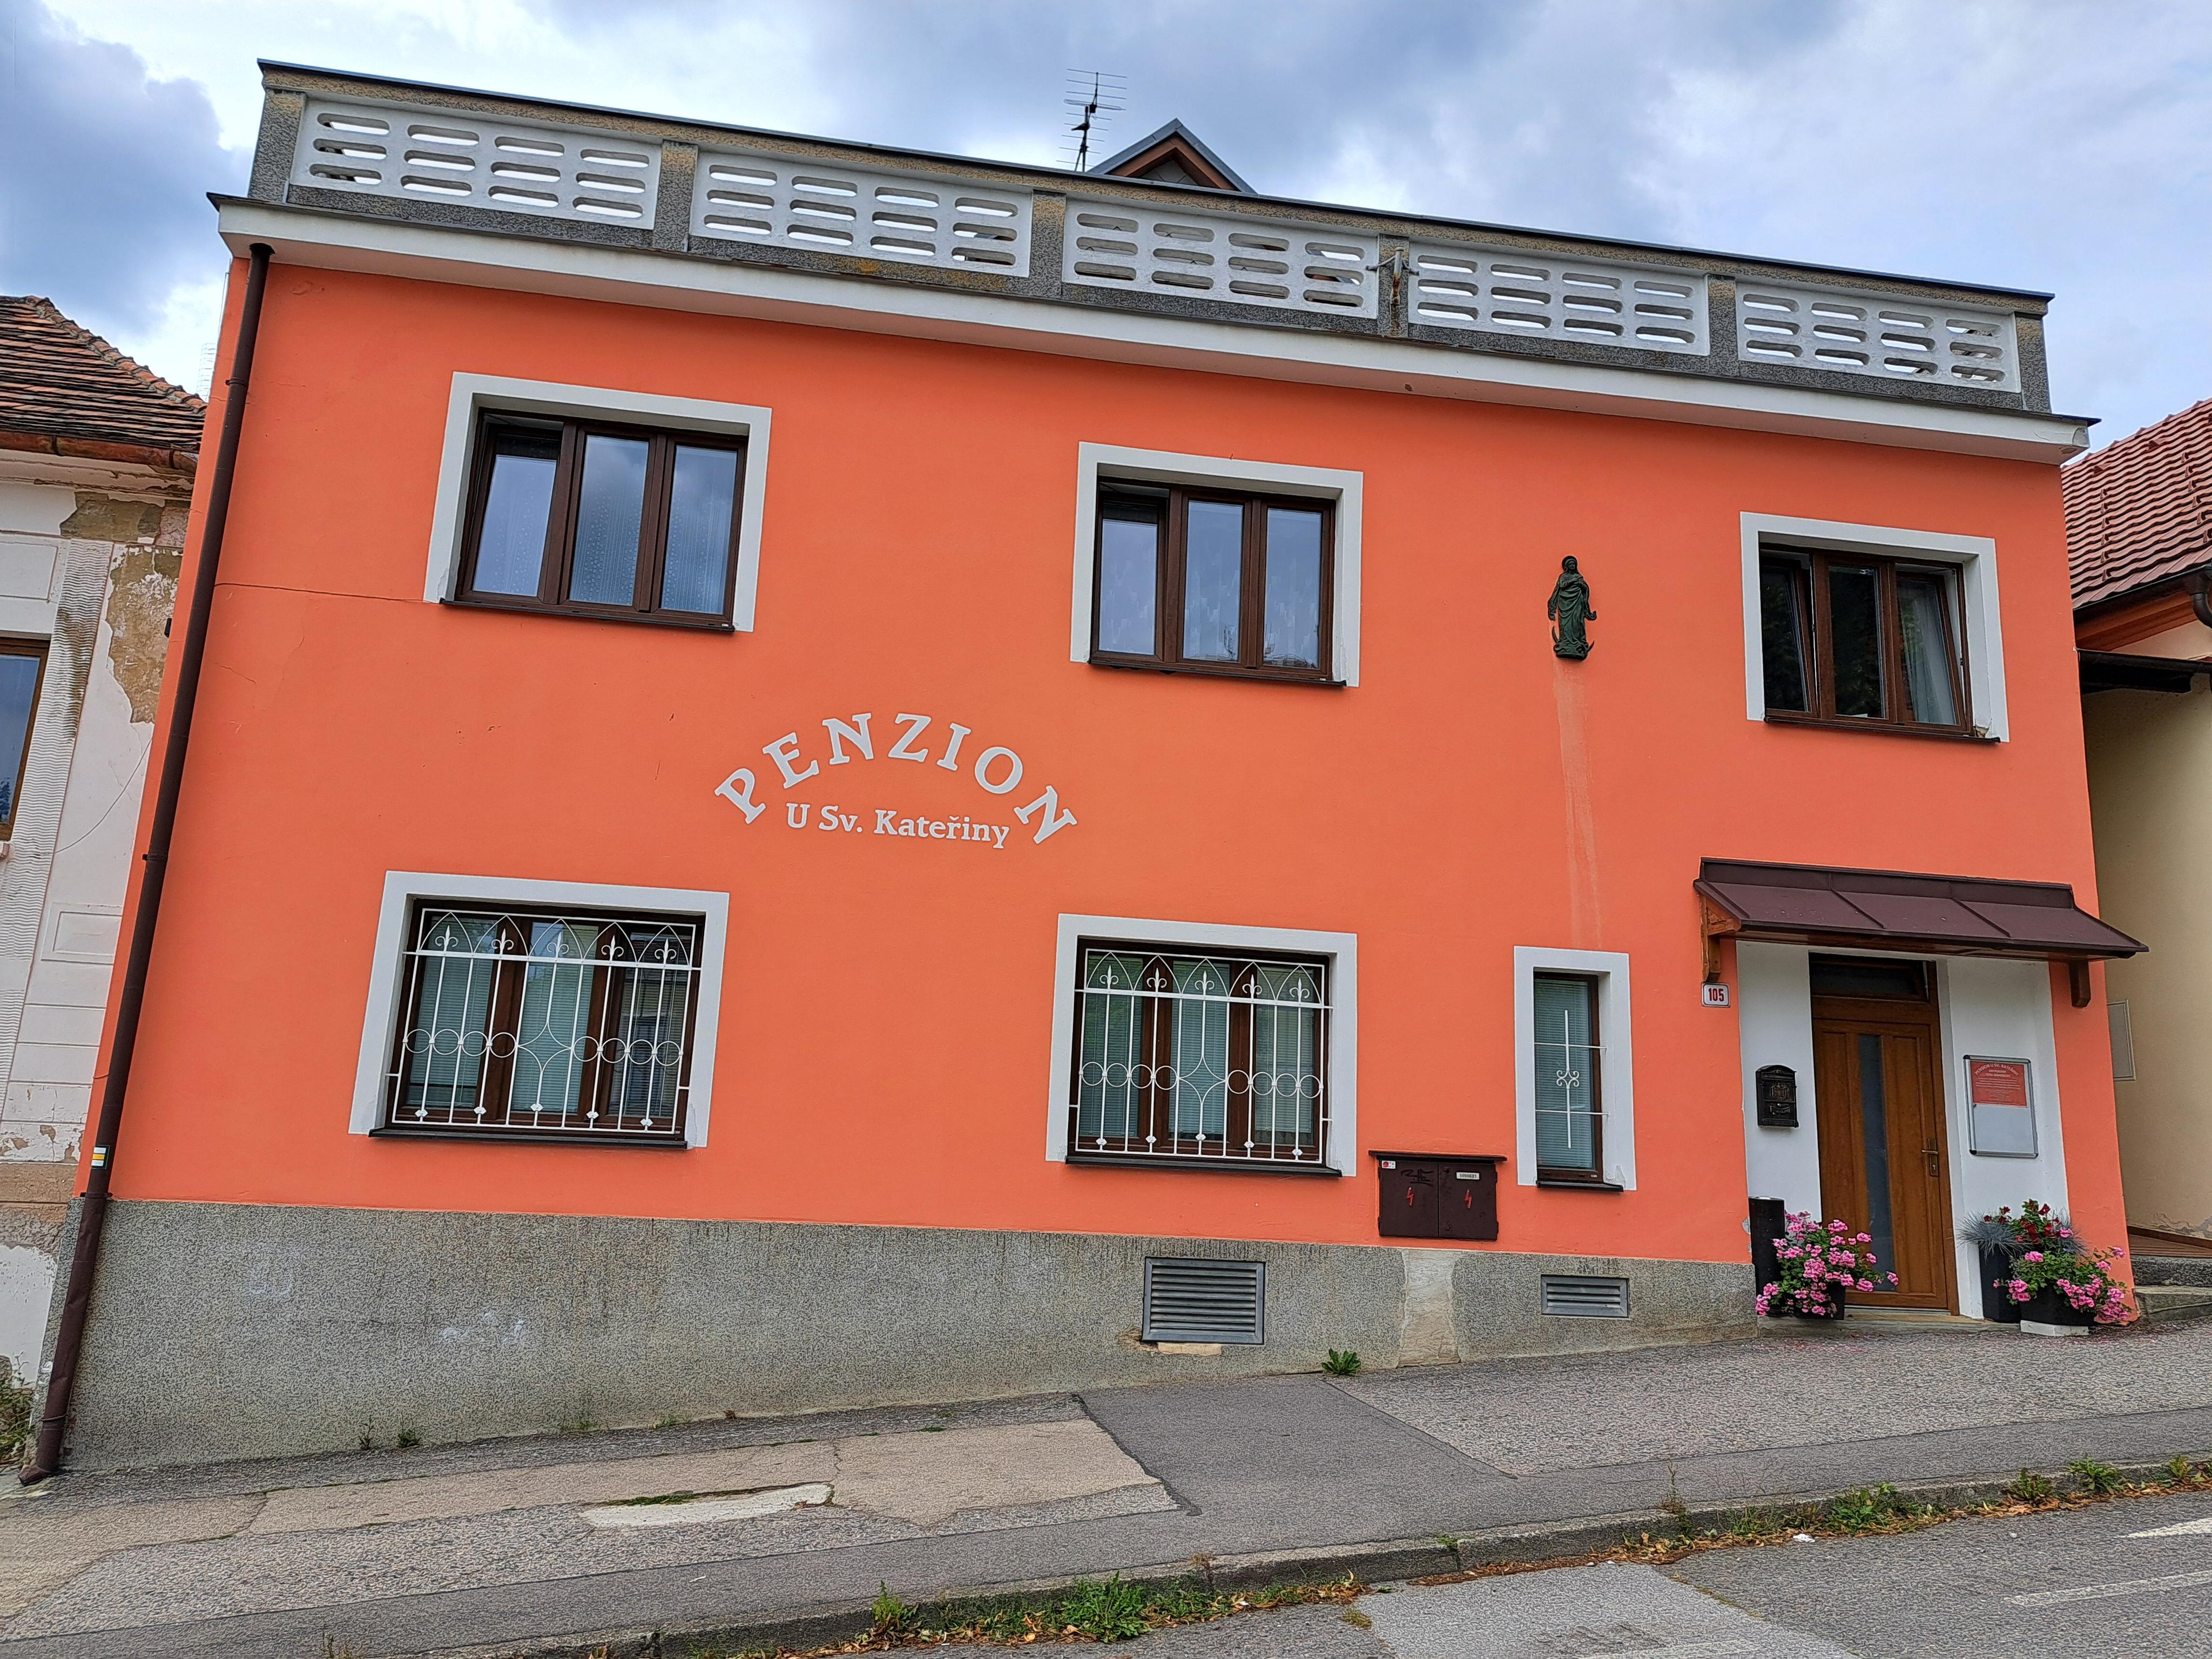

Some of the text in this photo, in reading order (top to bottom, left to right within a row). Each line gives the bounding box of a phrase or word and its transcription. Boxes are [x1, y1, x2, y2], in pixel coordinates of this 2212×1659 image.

[713, 712, 1078, 845] PENZION
[786, 802, 1010, 849] U Sv. Kateřiny
[1708, 988, 1724, 1002] 105
